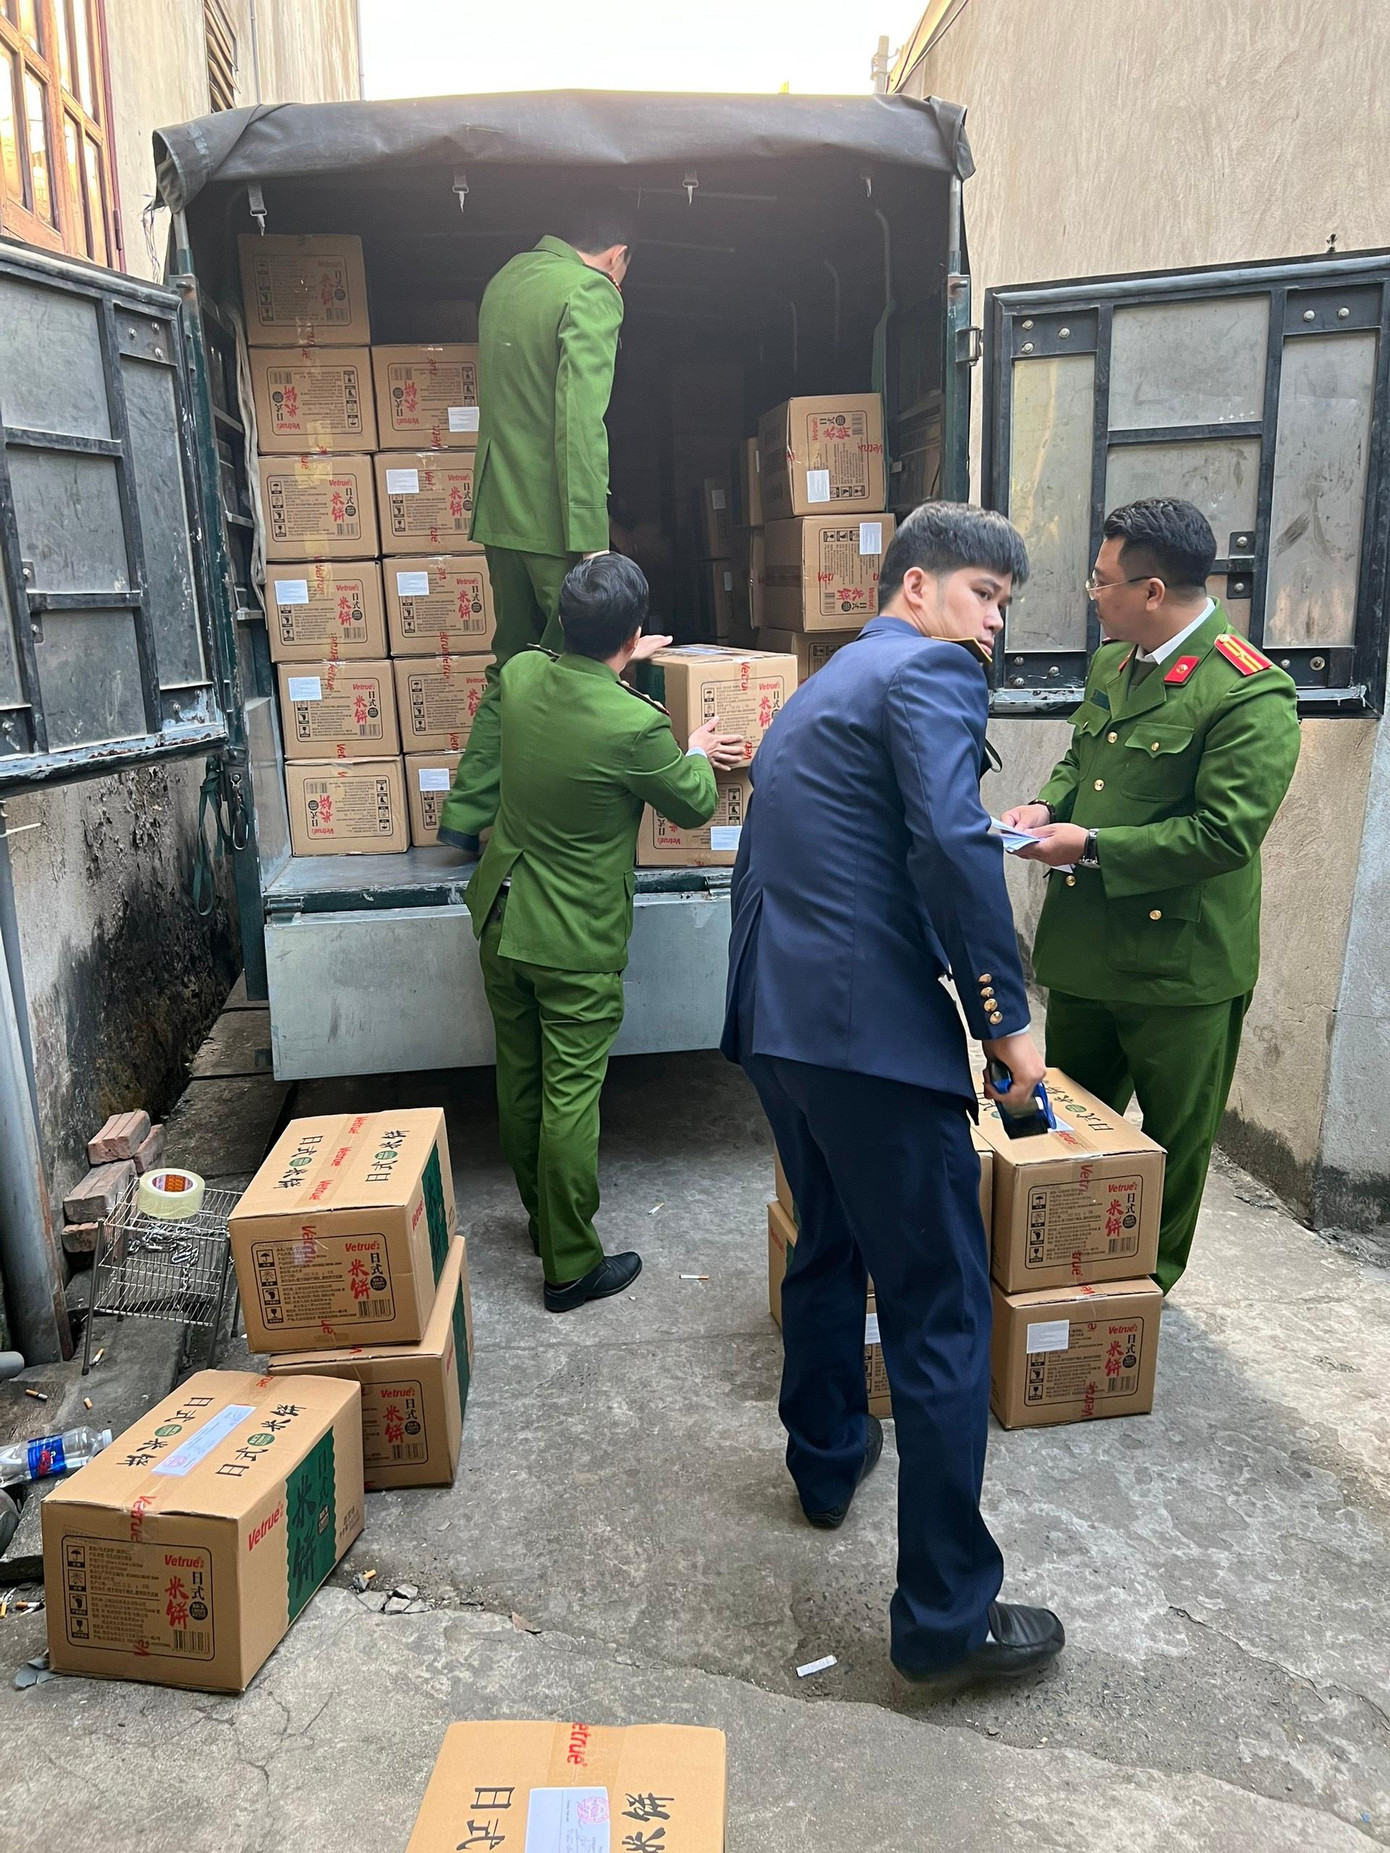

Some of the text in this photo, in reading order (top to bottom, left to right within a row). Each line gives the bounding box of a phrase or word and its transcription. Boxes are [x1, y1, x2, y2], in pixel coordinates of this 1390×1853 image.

[1105, 1199, 1124, 1238] 米饼
[348, 1259, 371, 1300] 米饼
[370, 1253, 383, 1275] 日式
[383, 1405, 405, 1444] 米饼
[405, 1399, 418, 1420] 日式
[165, 1576, 189, 1630] 米饼
[192, 1571, 205, 1600] 日式
